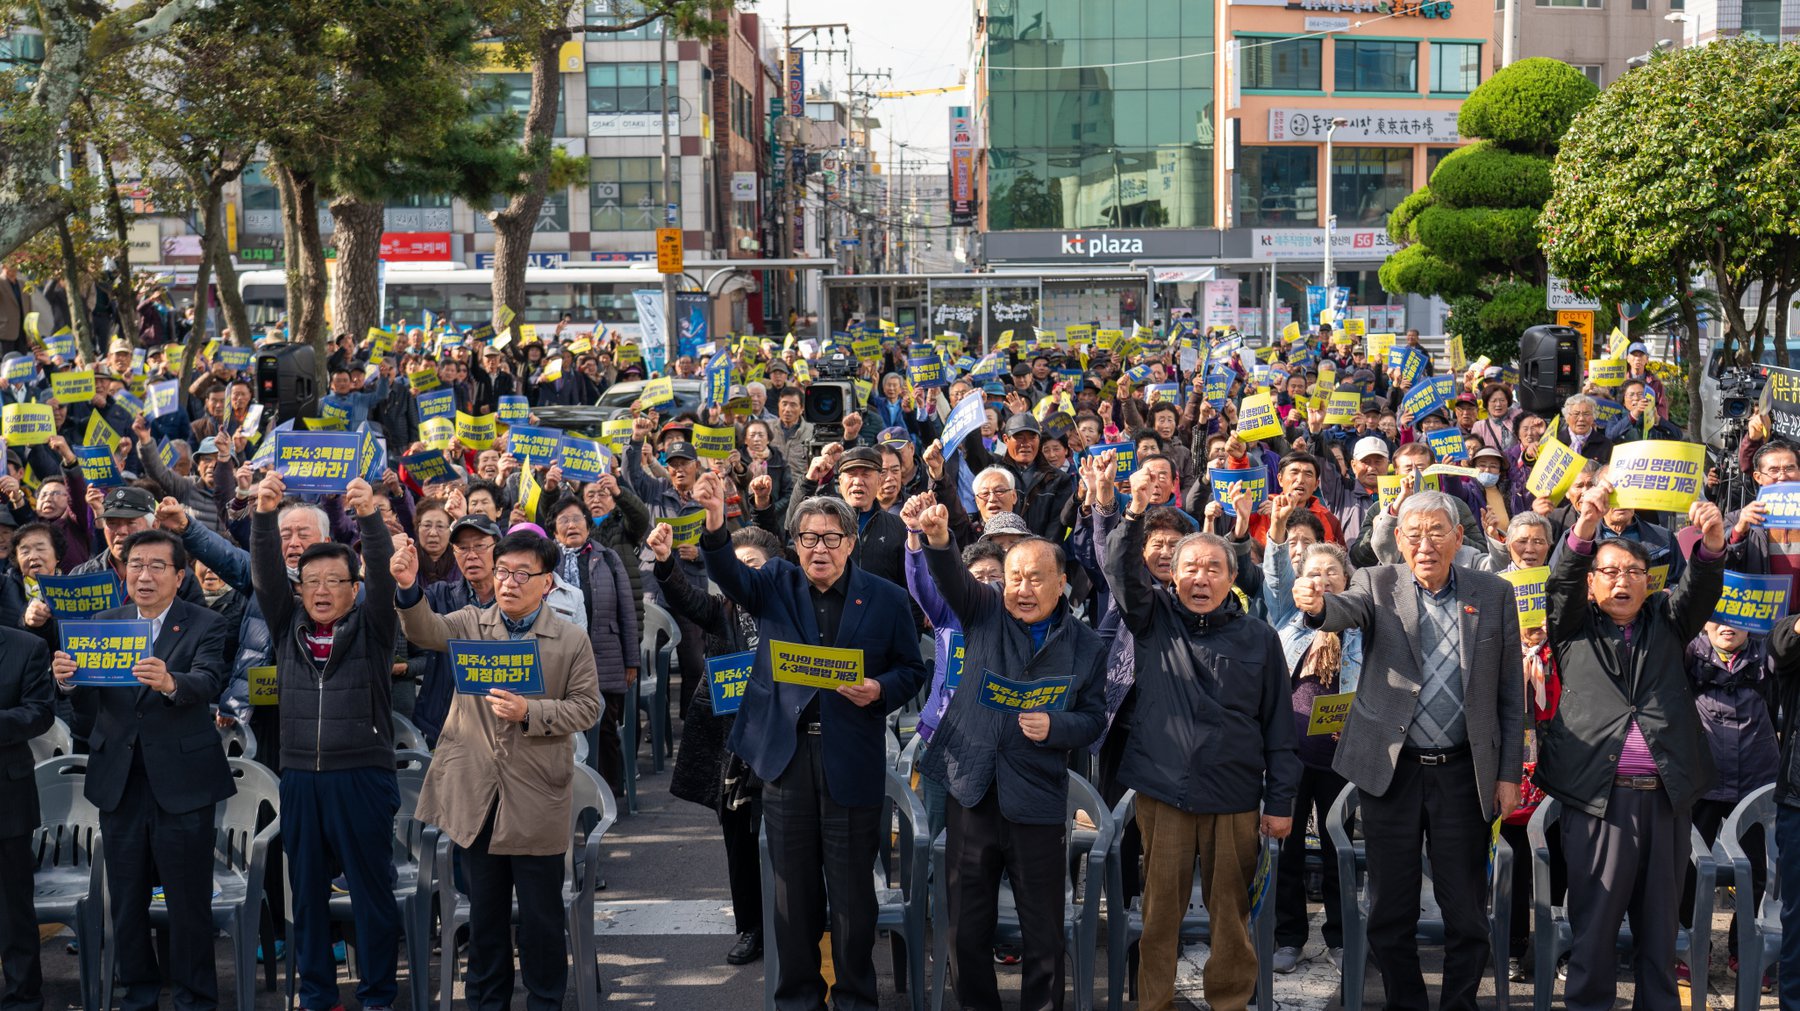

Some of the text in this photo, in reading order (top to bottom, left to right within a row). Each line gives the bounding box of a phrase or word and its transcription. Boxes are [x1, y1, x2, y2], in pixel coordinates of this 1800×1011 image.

[1311, 114, 1372, 136] 동경시장
[736, 183, 753, 191] CU
[1062, 234, 1143, 257] kt plaza
[1261, 235, 1273, 246] kt
[1357, 234, 1371, 247] 5G
[281, 446, 356, 460] 제주4·3특별법
[284, 460, 349, 479] 개정하라!
[1616, 458, 1698, 476] 역사의 명령이다
[1671, 476, 1697, 495] 개정
[45, 583, 113, 598] 제주4·3특별법
[1721, 585, 1786, 603] 주4·3특별법
[54, 598, 111, 612] 개정하라!
[68, 636, 147, 650] 제주4·3특별법
[76, 649, 142, 669] 개정하라!
[457, 653, 534, 667] 제주4·3특별법
[779, 652, 858, 670] 역사의 명령이다
[466, 667, 530, 683] 개정하라!
[714, 667, 752, 684] 제주4·3
[779, 662, 858, 683] 4·3특별법 개정
[256, 678, 278, 686] 역사
[986, 681, 1067, 698] 제주4·3특별법
[991, 693, 1058, 709] 개정하라!
[1319, 703, 1349, 713] 역사의
[1316, 713, 1347, 725] 4·3특
